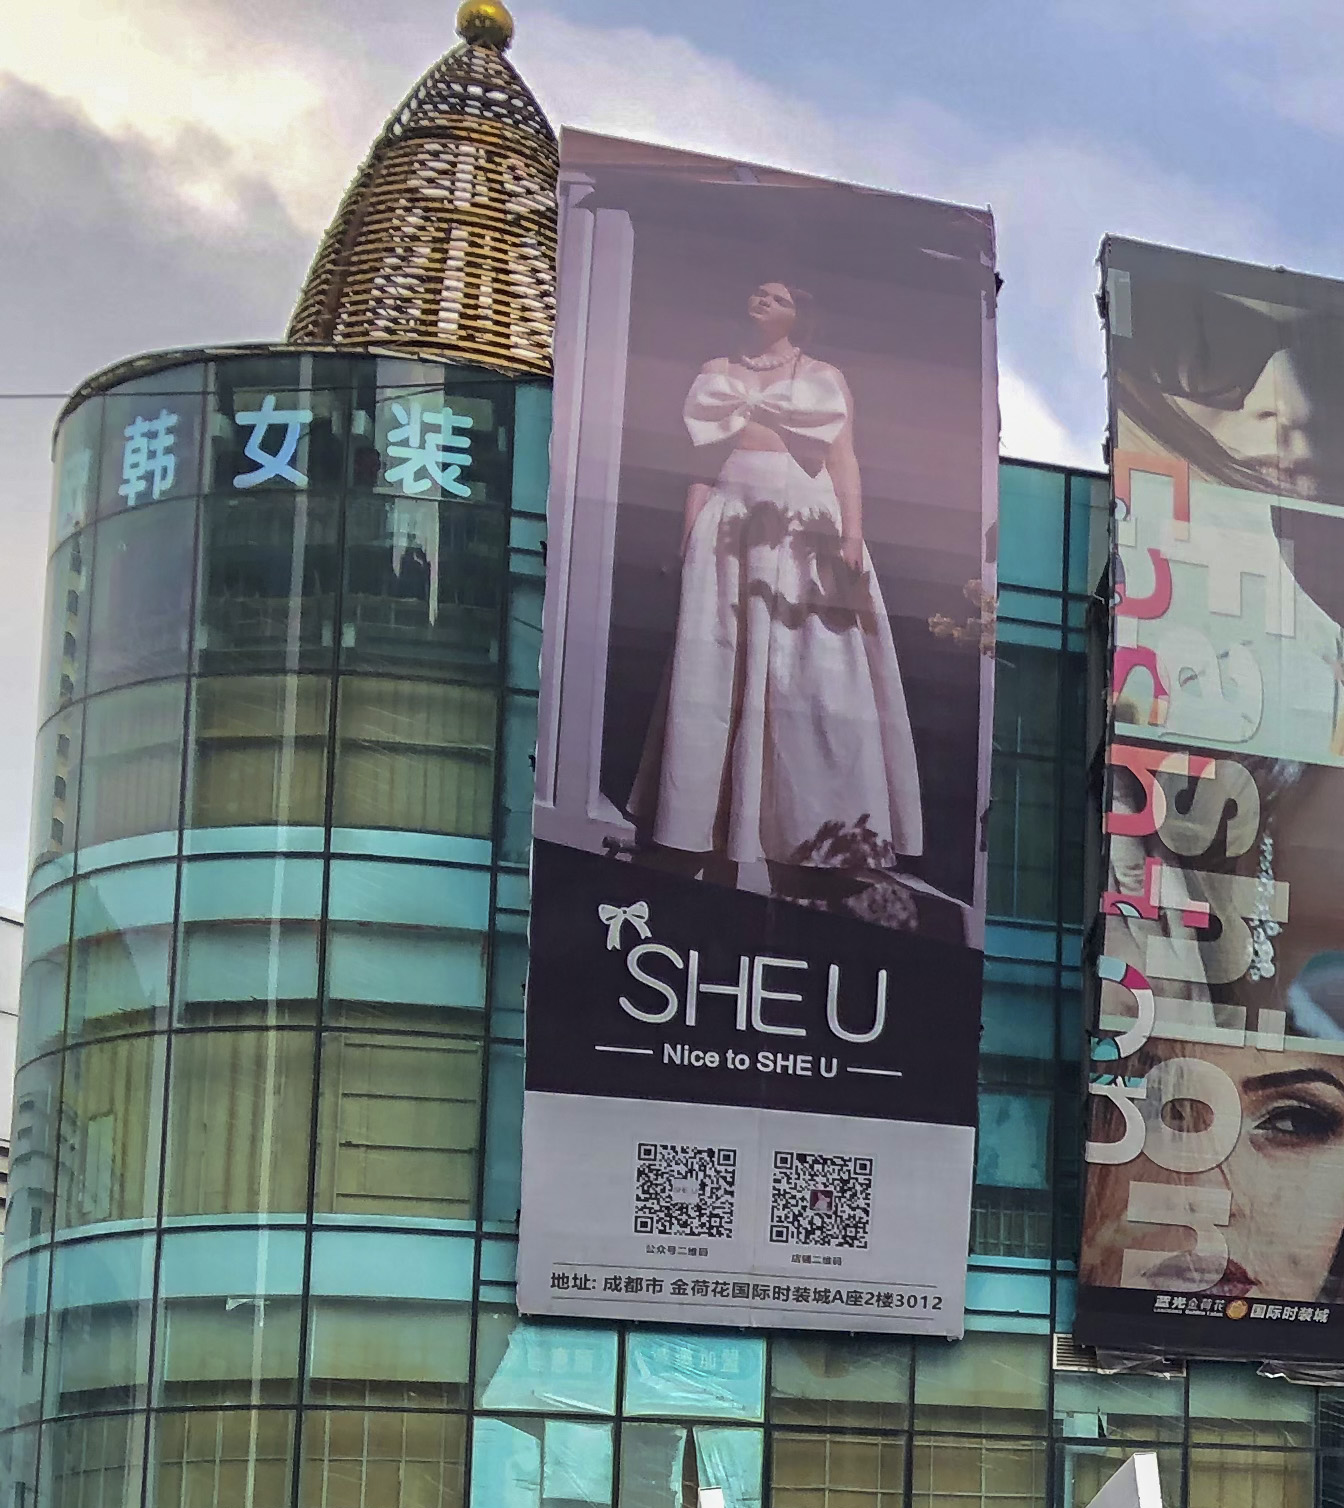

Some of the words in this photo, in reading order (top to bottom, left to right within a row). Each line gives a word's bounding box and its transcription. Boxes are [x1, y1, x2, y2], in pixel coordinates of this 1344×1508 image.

[618, 943, 809, 1037] SHE
[826, 963, 888, 1043] U
[662, 1043, 720, 1069] Nice
[726, 1049, 751, 1071] to
[757, 1053, 813, 1077] SHE
[820, 1058, 838, 1079] U
[645, 1244, 709, 1257] 公众号二维码
[602, 1276, 664, 1296] 成都市
[1250, 1304, 1330, 1323] 国际时装城
